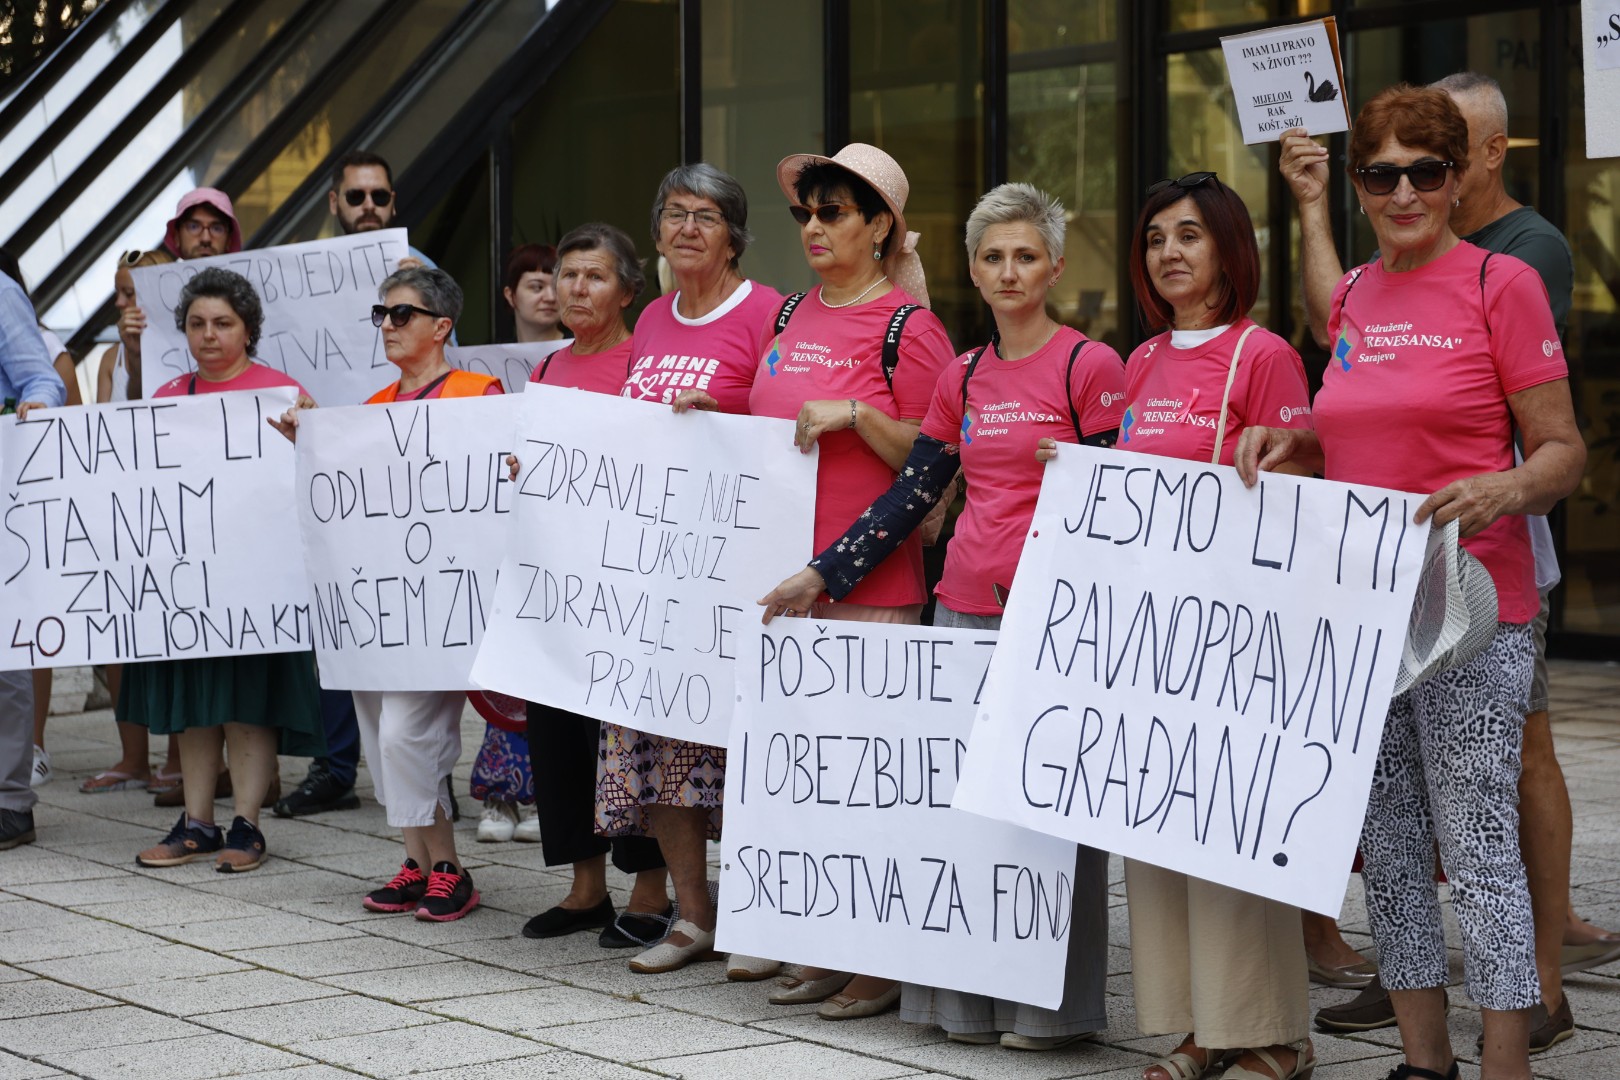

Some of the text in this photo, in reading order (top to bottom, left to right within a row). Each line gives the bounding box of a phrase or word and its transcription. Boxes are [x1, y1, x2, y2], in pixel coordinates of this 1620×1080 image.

[1242, 36, 1315, 59] IMAM LI PRAVO
[1252, 52, 1312, 72] NA ŽIVOT ???
[1252, 90, 1293, 105] MIJELOM
[1267, 105, 1286, 117] RAK
[1258, 115, 1304, 132] KOŠT. SRŽI
[778, 292, 806, 327] PINK
[1365, 321, 1413, 333] Udruženje
[656, 354, 720, 376] MENE
[782, 364, 811, 374] Sarajevo
[795, 341, 831, 354] Udruženje
[1358, 352, 1396, 364] Sarajevo
[658, 371, 712, 390] TEBE
[1147, 398, 1183, 410] Udruženje
[15, 396, 262, 485] ZNATE LI
[386, 404, 430, 457] VI
[976, 426, 1008, 438] Sarajevo
[1136, 426, 1164, 437] Sarajevo
[310, 452, 512, 523] ODLUČUJE
[699, 470, 761, 530] NIJE
[4, 477, 216, 586] ŠTA NAM
[405, 521, 432, 565] O
[601, 520, 727, 582] LUKSUZ
[1064, 463, 1407, 593] JESMO LI MI
[61, 556, 210, 614] ZNAČI
[314, 566, 428, 650] NAŠEM
[10, 603, 312, 666] 40 MILIONA KM
[693, 604, 743, 660] JE
[761, 624, 954, 702] POŠTUJTE
[1035, 578, 1382, 754] RAVNOPRAVNI
[585, 650, 711, 725] PRAVO
[741, 731, 748, 805] I
[731, 845, 1072, 943] SREDSTVA ZA FOND
